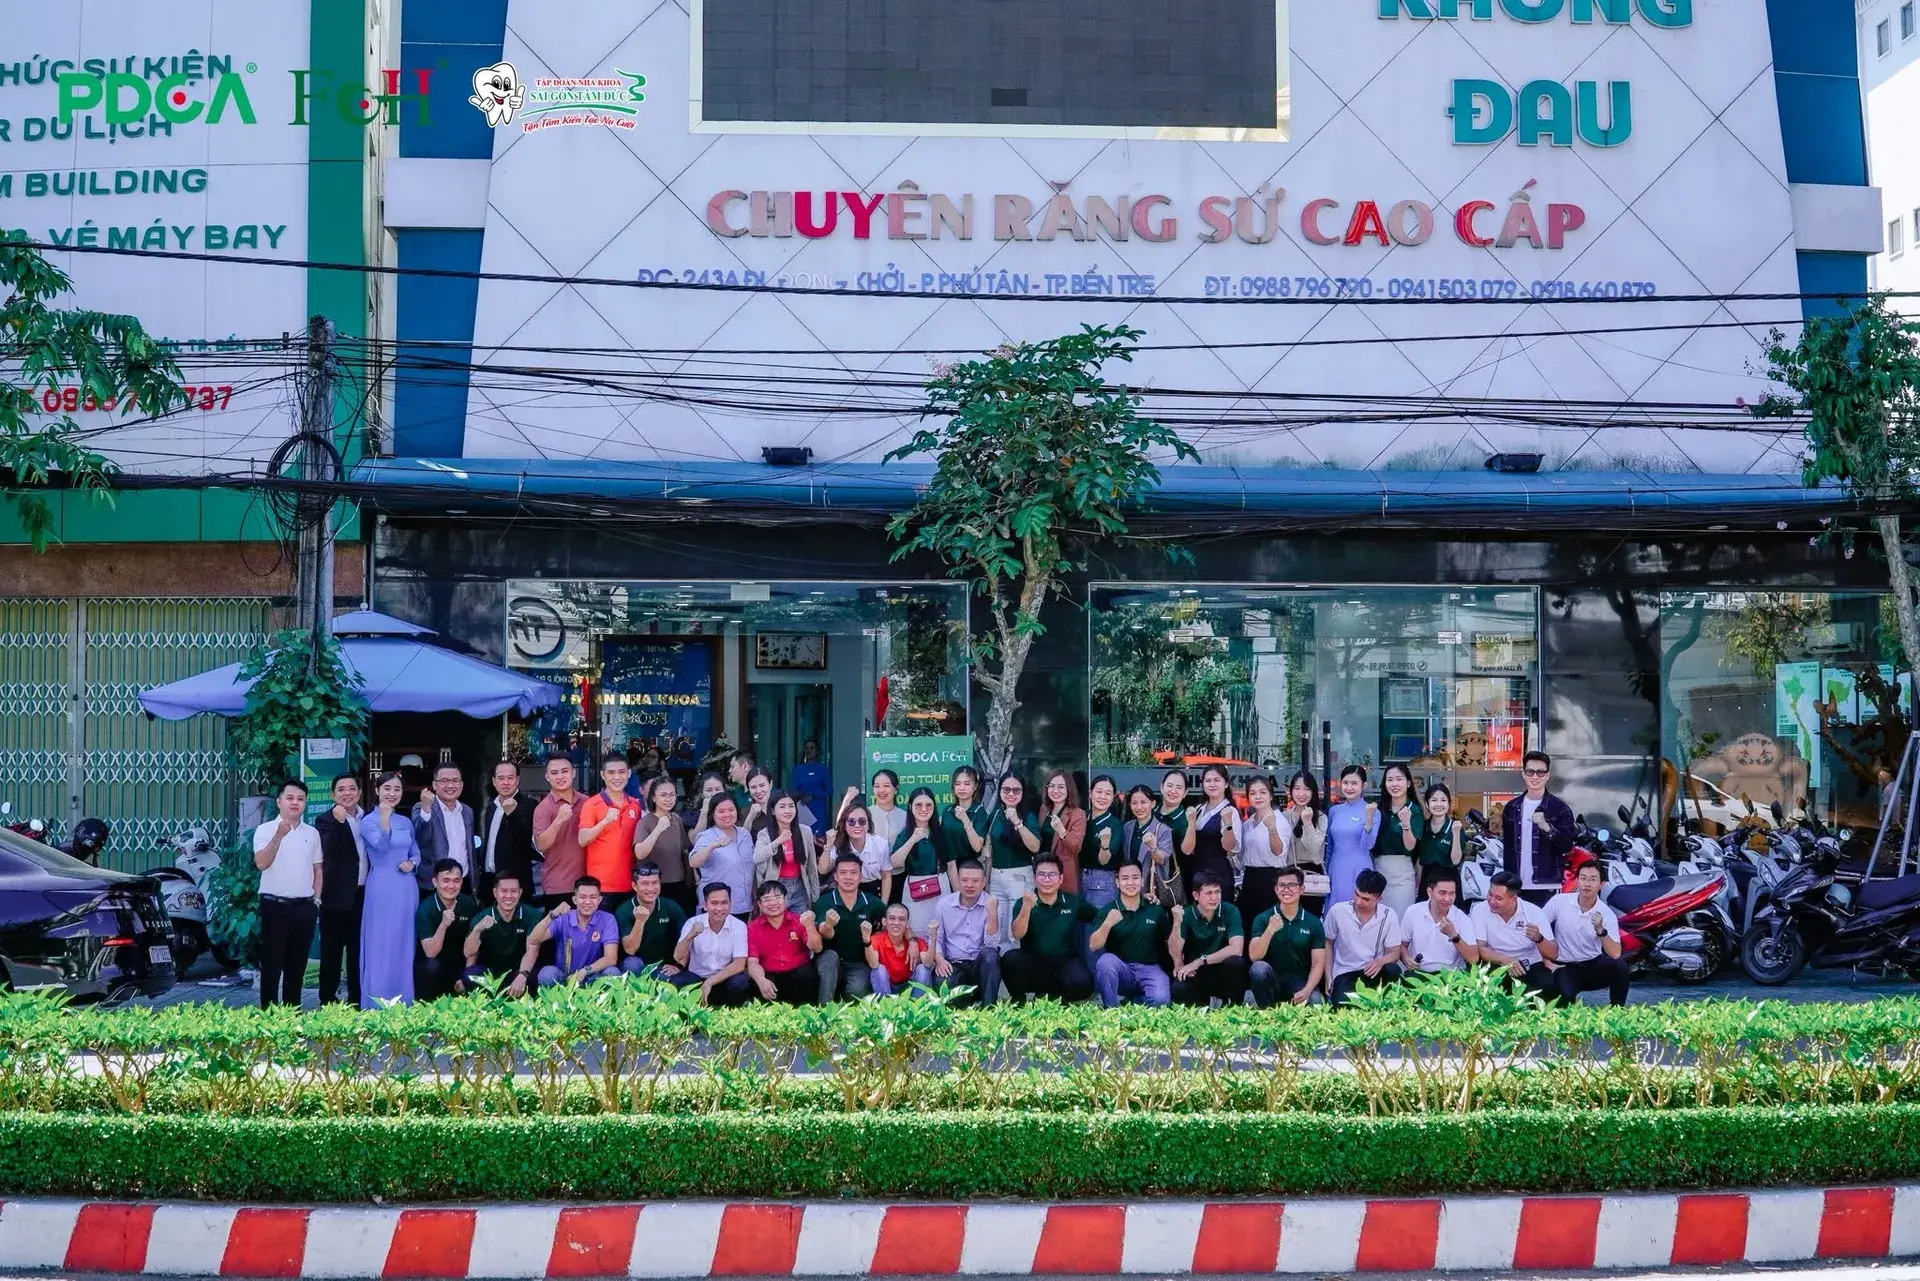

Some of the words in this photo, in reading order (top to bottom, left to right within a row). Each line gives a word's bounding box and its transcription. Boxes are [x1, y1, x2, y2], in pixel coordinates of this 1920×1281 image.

[1446, 78, 1633, 147] ĐAU
[25, 168, 208, 198] BUILDING
[705, 178, 973, 241] CHUYÊN
[993, 179, 1177, 244] RĂNG
[1199, 180, 1287, 245] SỨ
[1300, 198, 1434, 248] CAO
[1453, 177, 1587, 249] CẤP
[107, 218, 195, 250] MÁY
[204, 224, 287, 250] BAY
[985, 268, 1030, 295] TÂN
[1117, 273, 1156, 296] TRE
[903, 752, 938, 763] PDCA
[917, 774, 950, 784] TOUR
